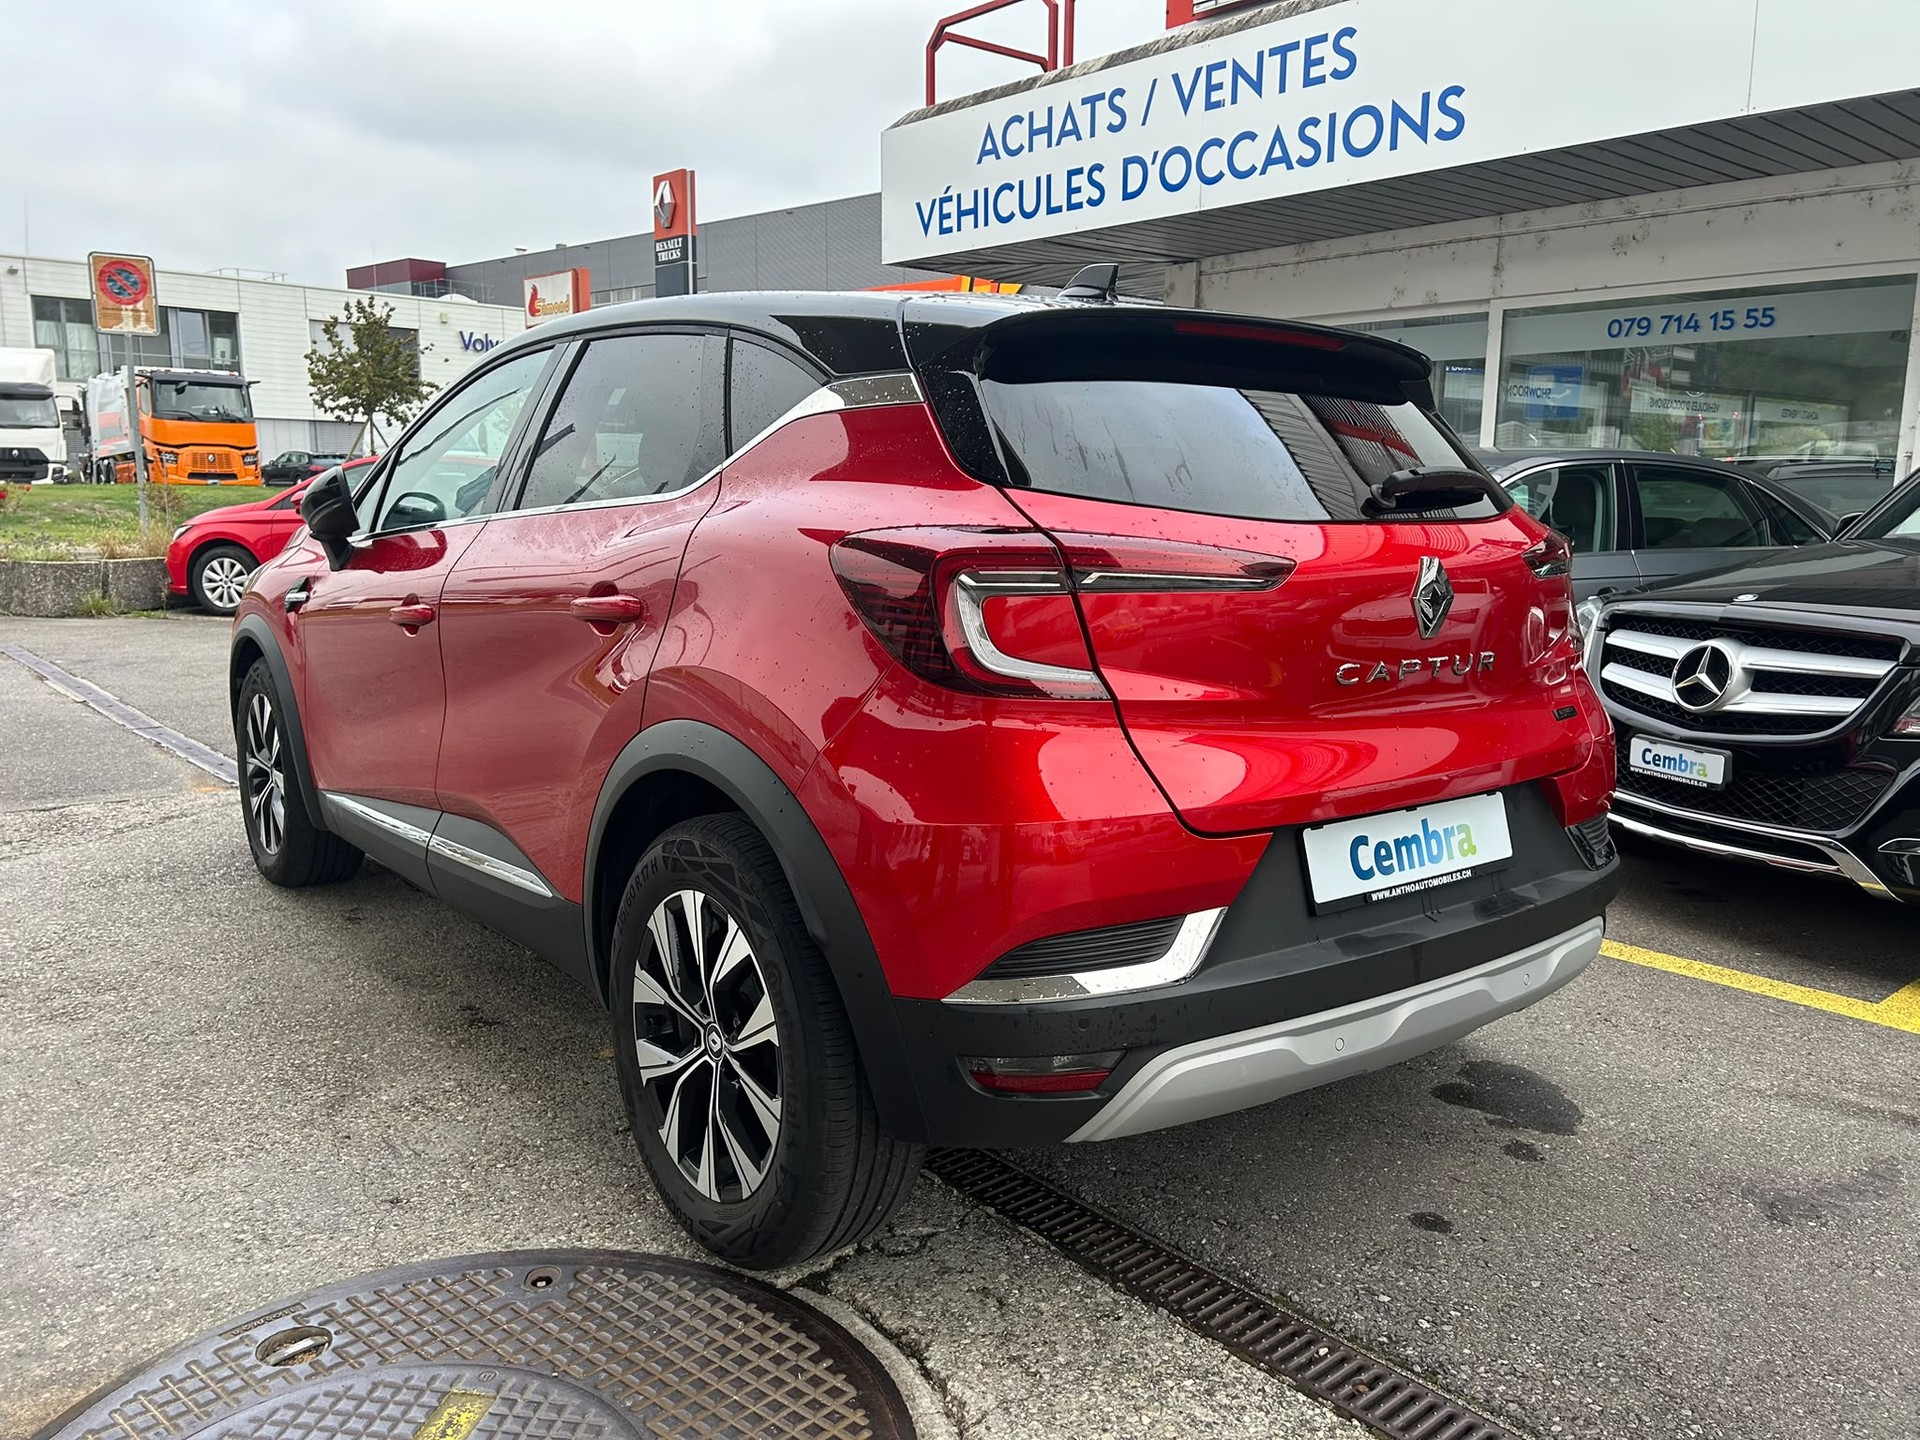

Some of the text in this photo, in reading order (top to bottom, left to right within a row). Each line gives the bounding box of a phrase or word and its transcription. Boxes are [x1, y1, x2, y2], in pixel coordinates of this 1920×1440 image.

[977, 27, 1358, 165] ACHATS / VENTES
[916, 85, 1466, 238] VÉHICULES D'OCCASIONS
[655, 237, 683, 252] RENAULT
[657, 248, 681, 262] TRUCKS
[1607, 306, 1776, 339] 079 714 15 55
[459, 330, 503, 352] Volv
[1336, 651, 1497, 686] CAPTUR
[1630, 766, 1708, 788] WWW.ANTHOAUTOMOBILES.CH
[1641, 747, 1708, 778] Cembra
[1349, 817, 1477, 882] Cembra
[635, 875, 643, 892] R
[1371, 869, 1473, 902] WWW.ANTHOAUTOMOBILES.CH
